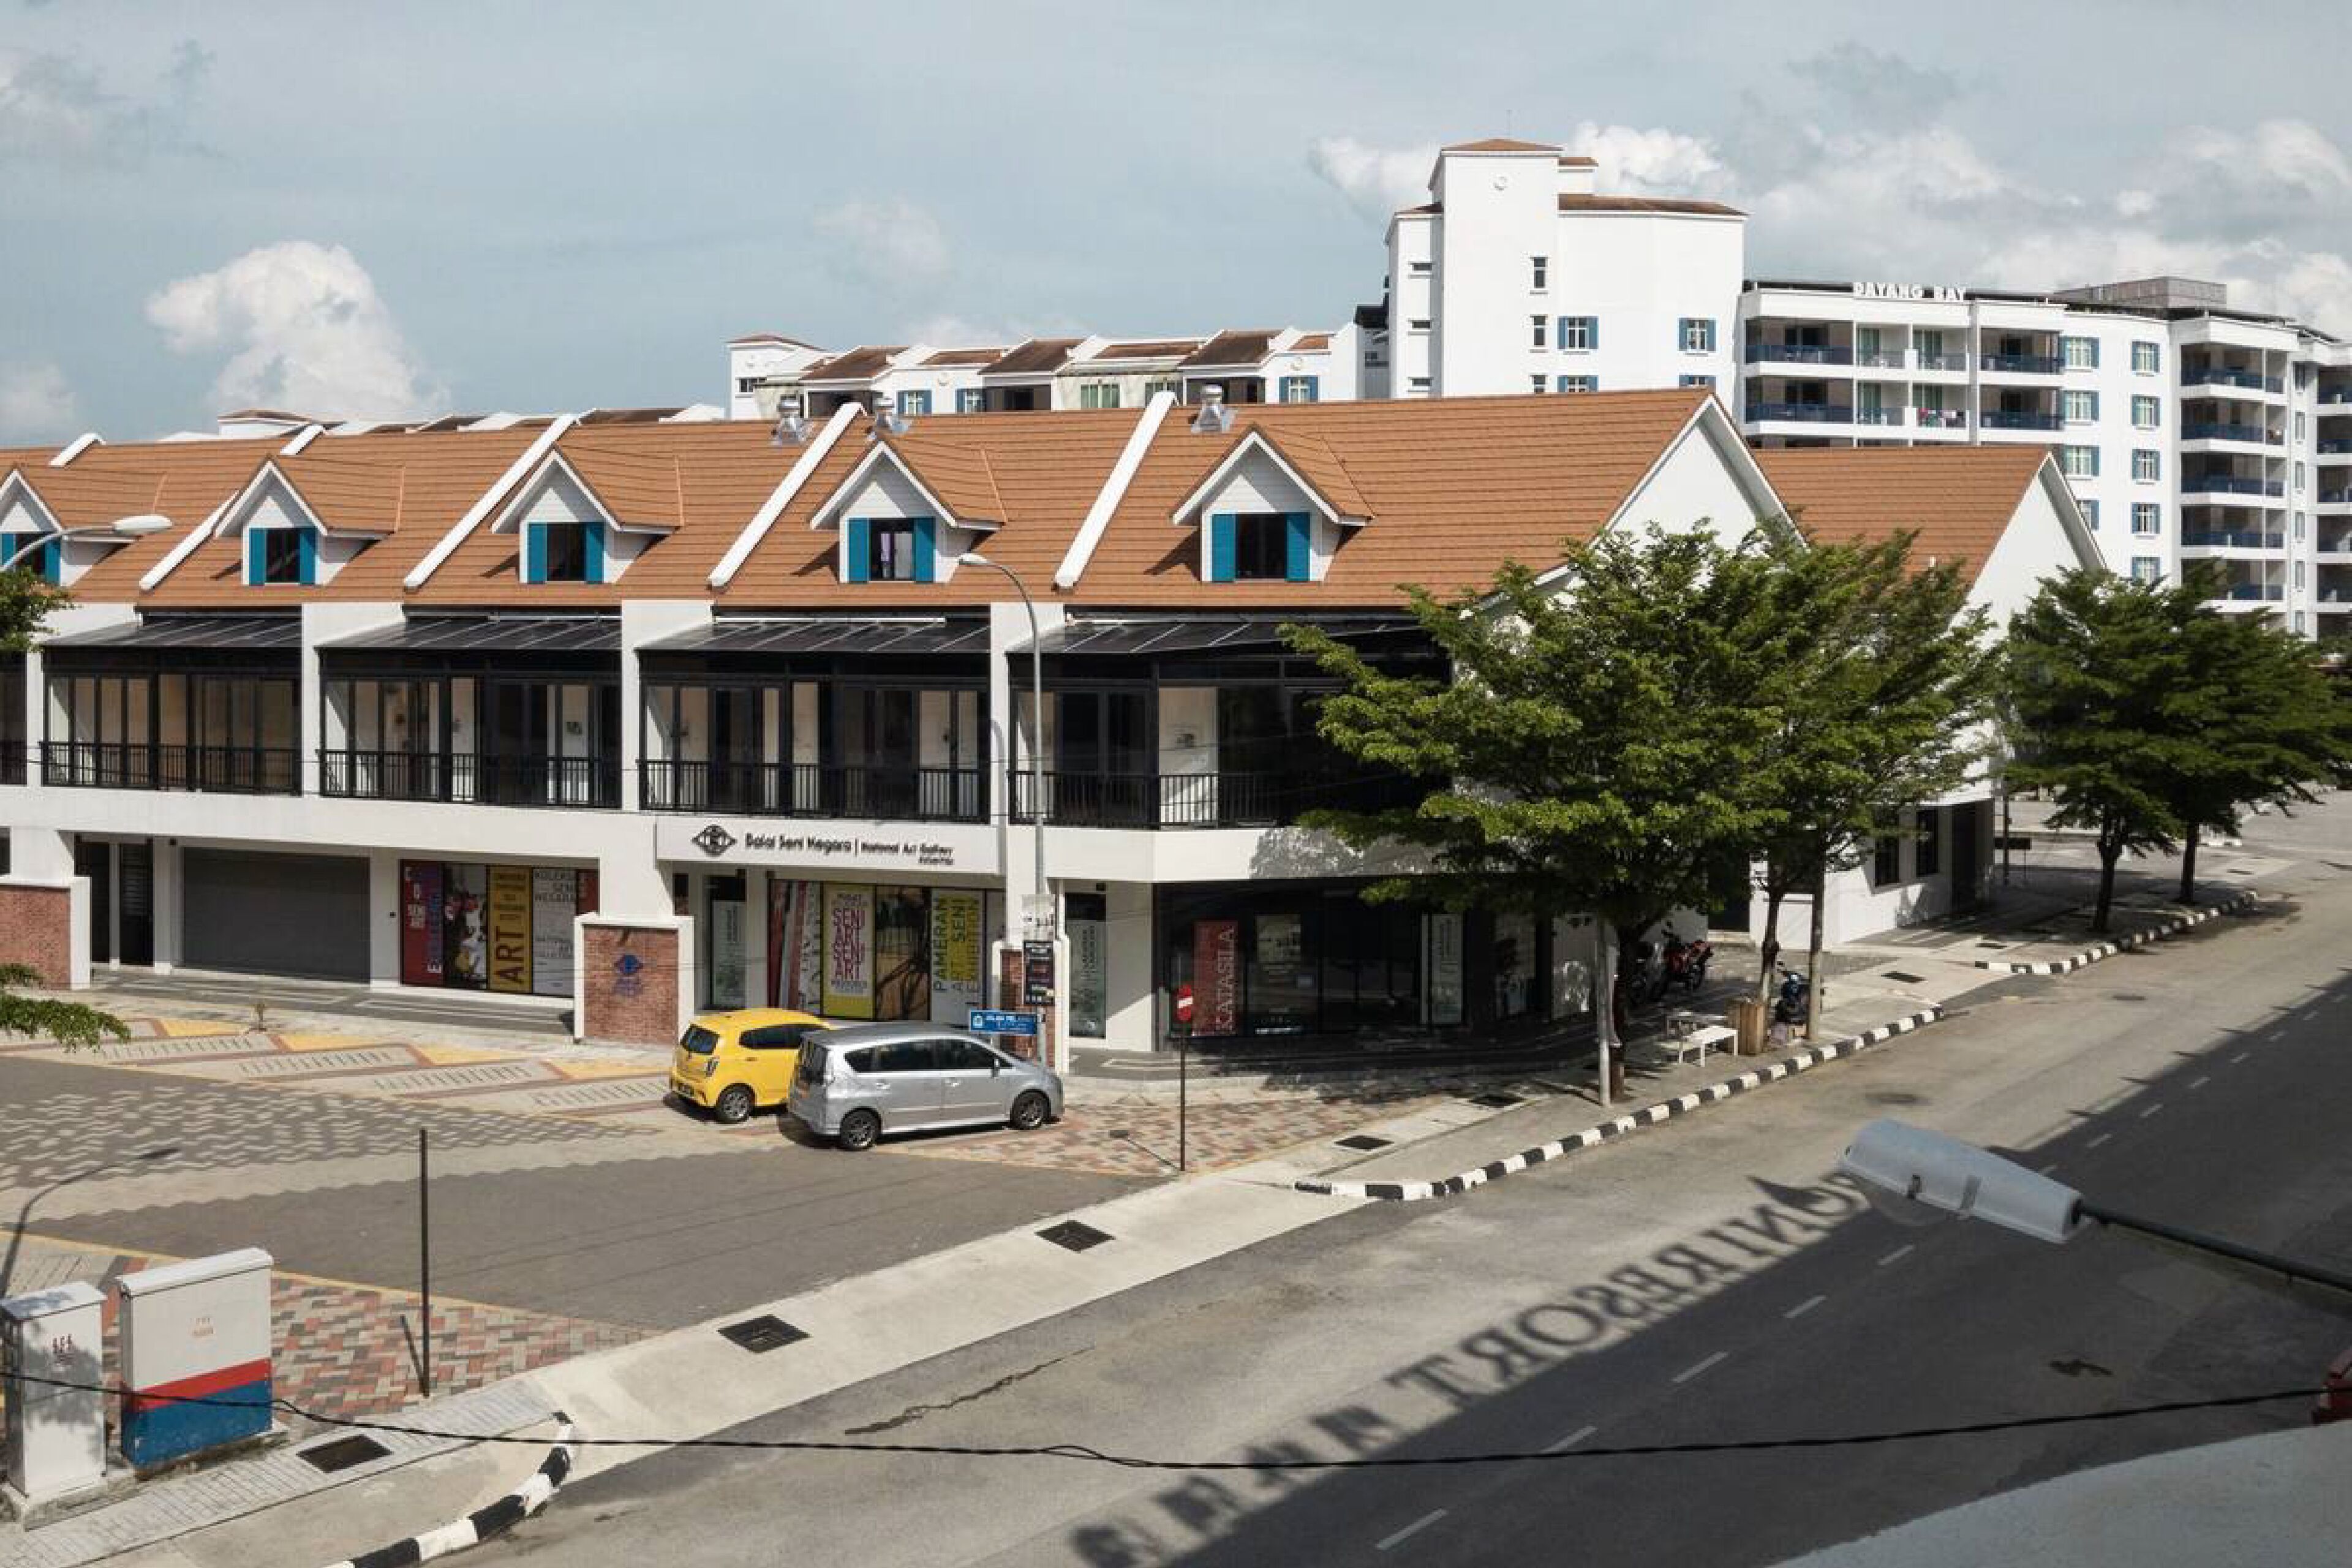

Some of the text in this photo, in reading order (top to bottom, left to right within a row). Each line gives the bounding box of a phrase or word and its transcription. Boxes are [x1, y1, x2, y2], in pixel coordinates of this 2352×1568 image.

[1853, 282, 1967, 303] DAYANG BAY
[745, 832, 775, 850] Balai
[778, 834, 804, 851] Seni
[807, 834, 851, 856] Negara
[833, 908, 865, 927] SENI
[951, 899, 966, 942] SENI
[493, 925, 525, 986] ART
[833, 942, 865, 961] SENI
[933, 898, 948, 992] PAMERAN
